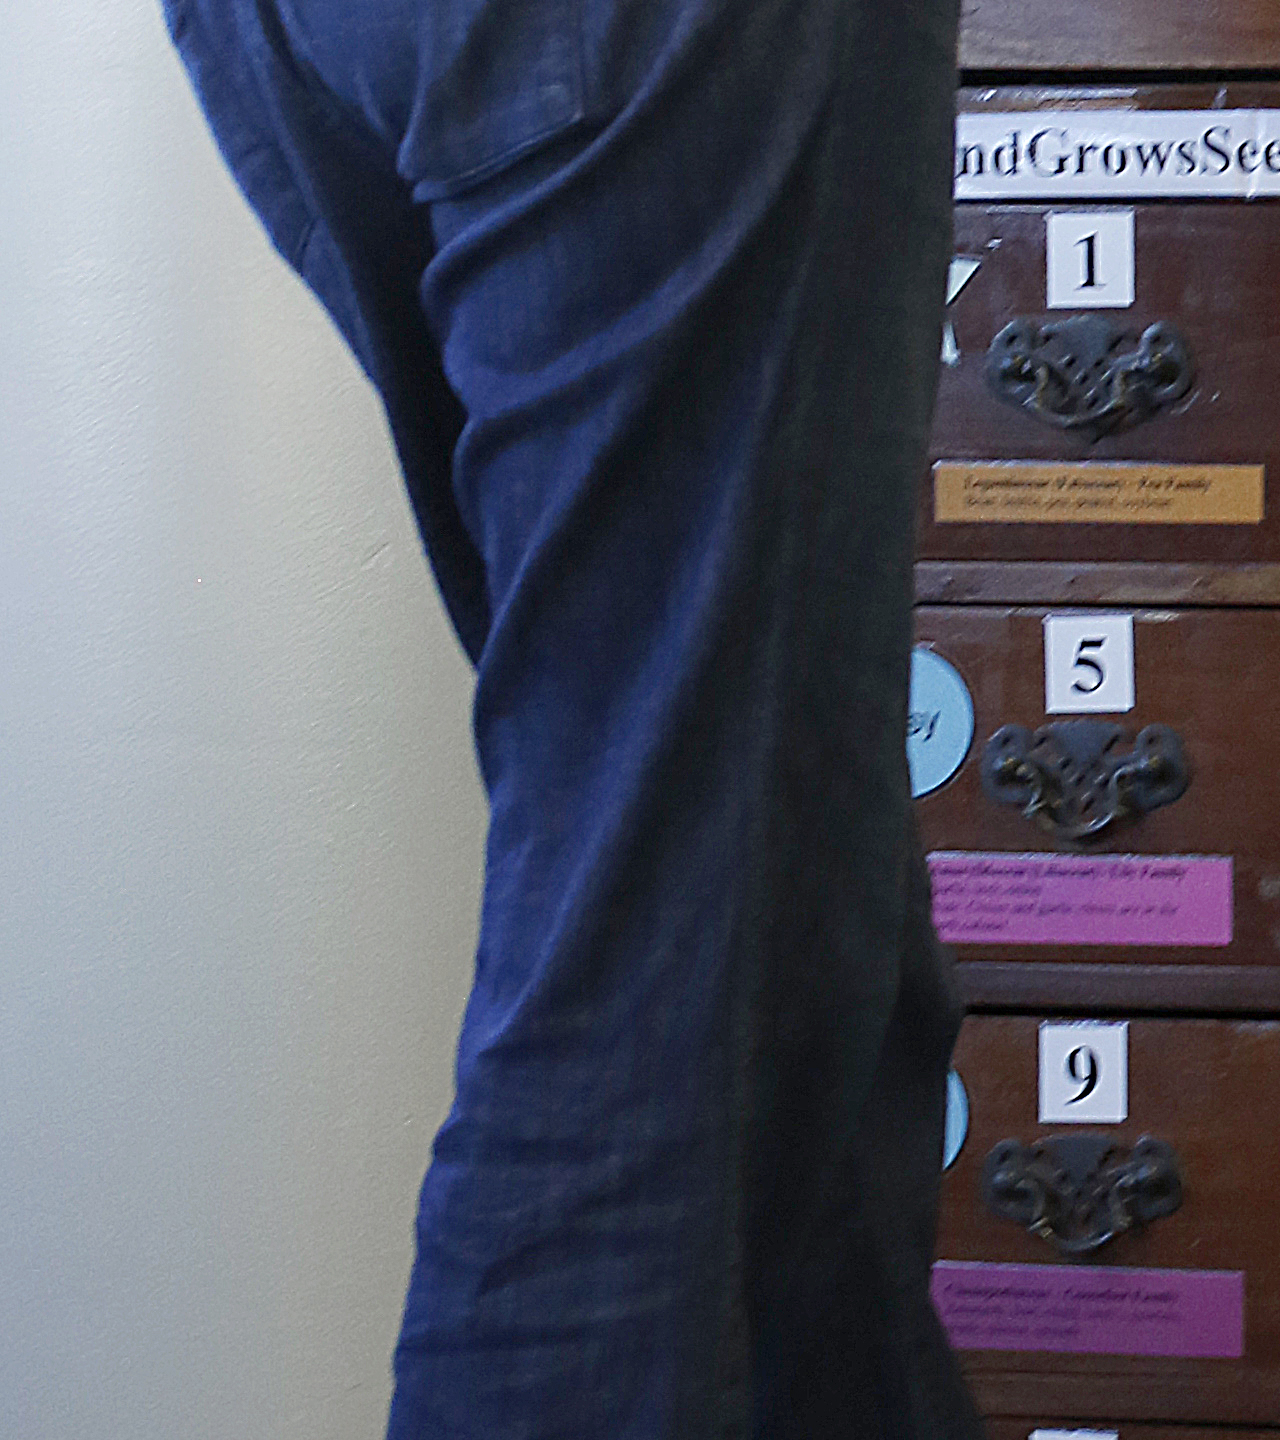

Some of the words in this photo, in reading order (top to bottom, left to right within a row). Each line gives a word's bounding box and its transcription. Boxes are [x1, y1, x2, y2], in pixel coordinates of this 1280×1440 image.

[1072, 230, 1107, 291] 1
[1071, 635, 1108, 694] 5
[1063, 1044, 1100, 1107] 9
